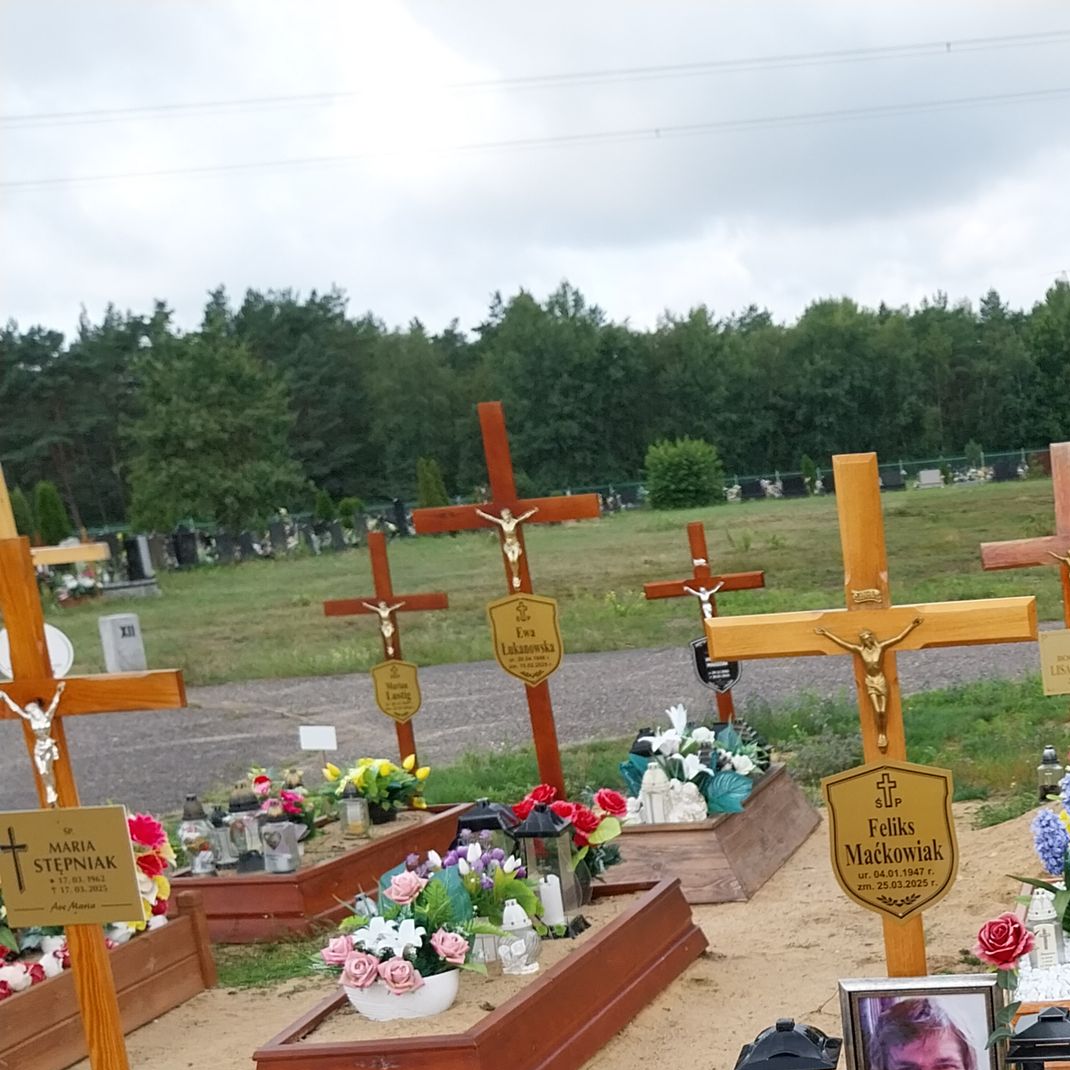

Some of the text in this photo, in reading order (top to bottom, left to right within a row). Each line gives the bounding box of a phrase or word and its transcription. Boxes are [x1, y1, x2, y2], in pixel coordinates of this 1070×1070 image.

[120, 624, 136, 639] XII
[516, 626, 536, 639] Ewa
[868, 817, 916, 838] Feliks
[49, 841, 97, 853] MARIA
[844, 839, 945, 867] Maćkowiak
[33, 856, 118, 875] STĘPNIAK
[858, 871, 871, 880] ur.
[874, 868, 925, 879] 04.01.1947
[857, 882, 875, 892] zm.
[877, 879, 929, 891] 25.03.2025
